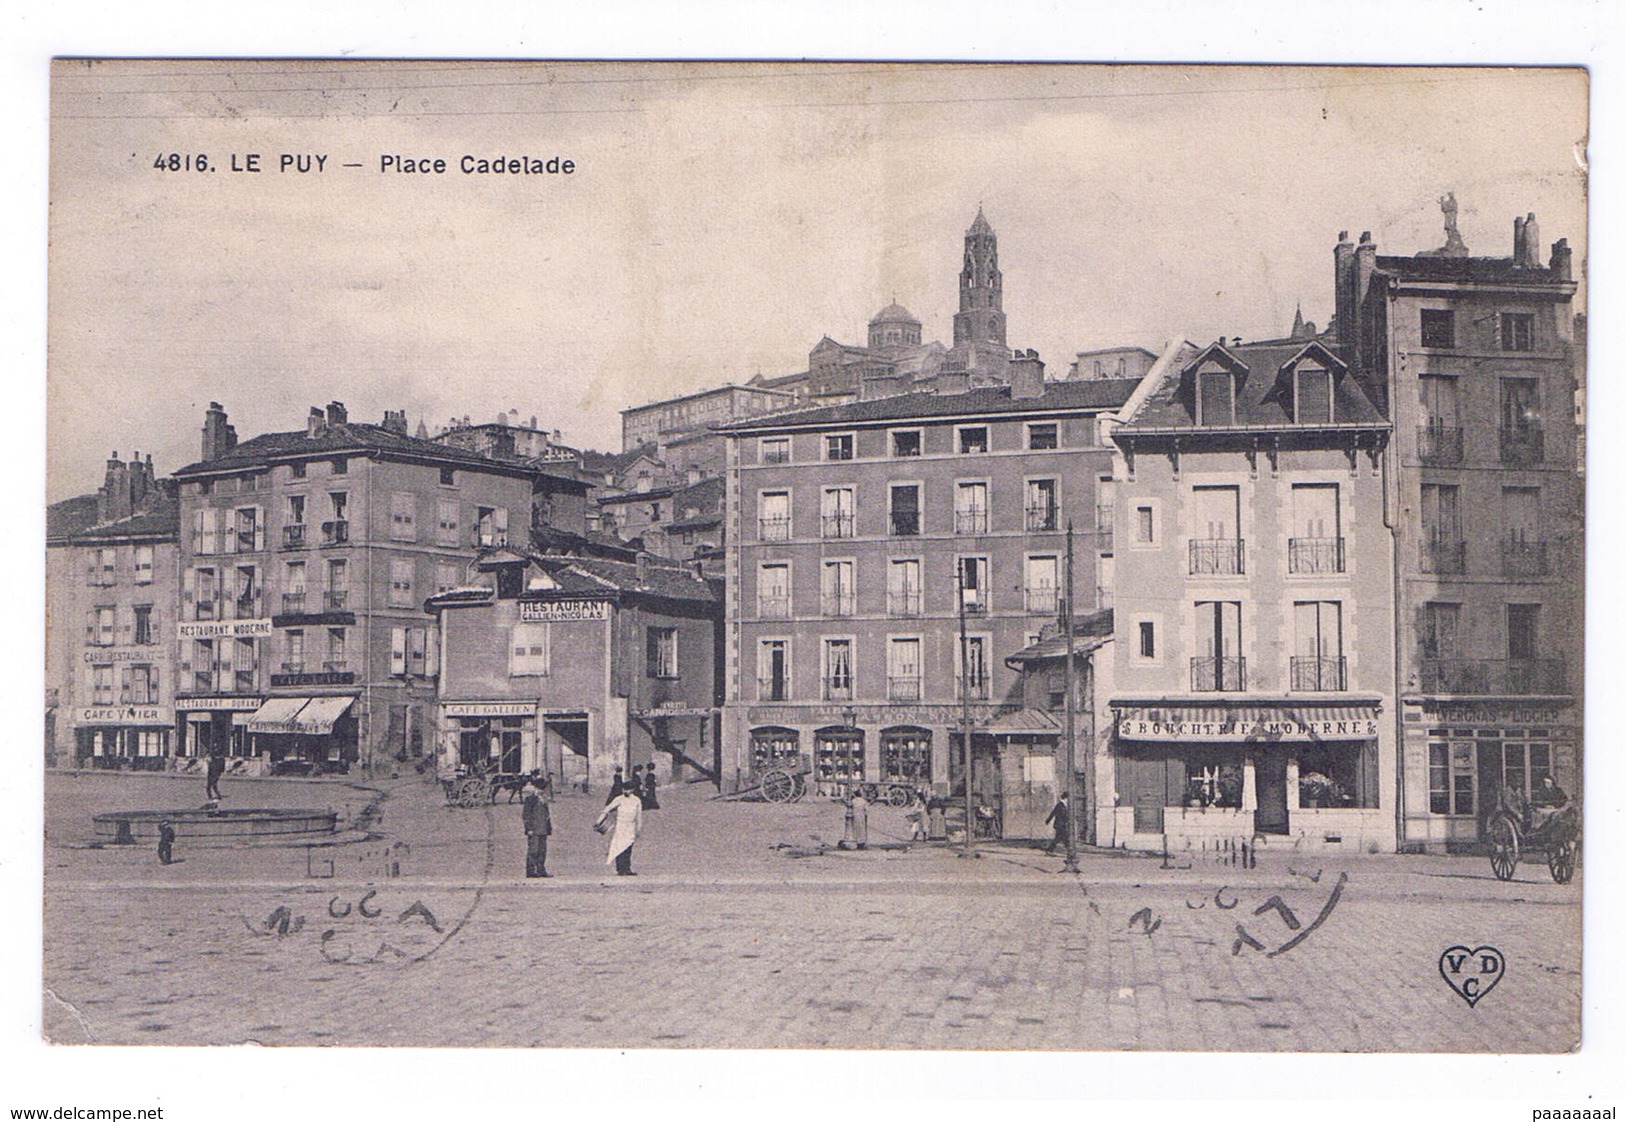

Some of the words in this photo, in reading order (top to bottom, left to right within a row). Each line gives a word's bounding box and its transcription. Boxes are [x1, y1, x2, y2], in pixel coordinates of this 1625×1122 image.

[523, 601, 606, 612] RESTAURANT
[180, 626, 228, 636] RESTAURANT
[233, 622, 269, 634] MODERNE
[176, 700, 221, 708] RESTAURANT
[488, 705, 531, 714] GALLIEN
[1138, 722, 1249, 735] BOUCHERIE
[1267, 722, 1362, 735] MODERNE
